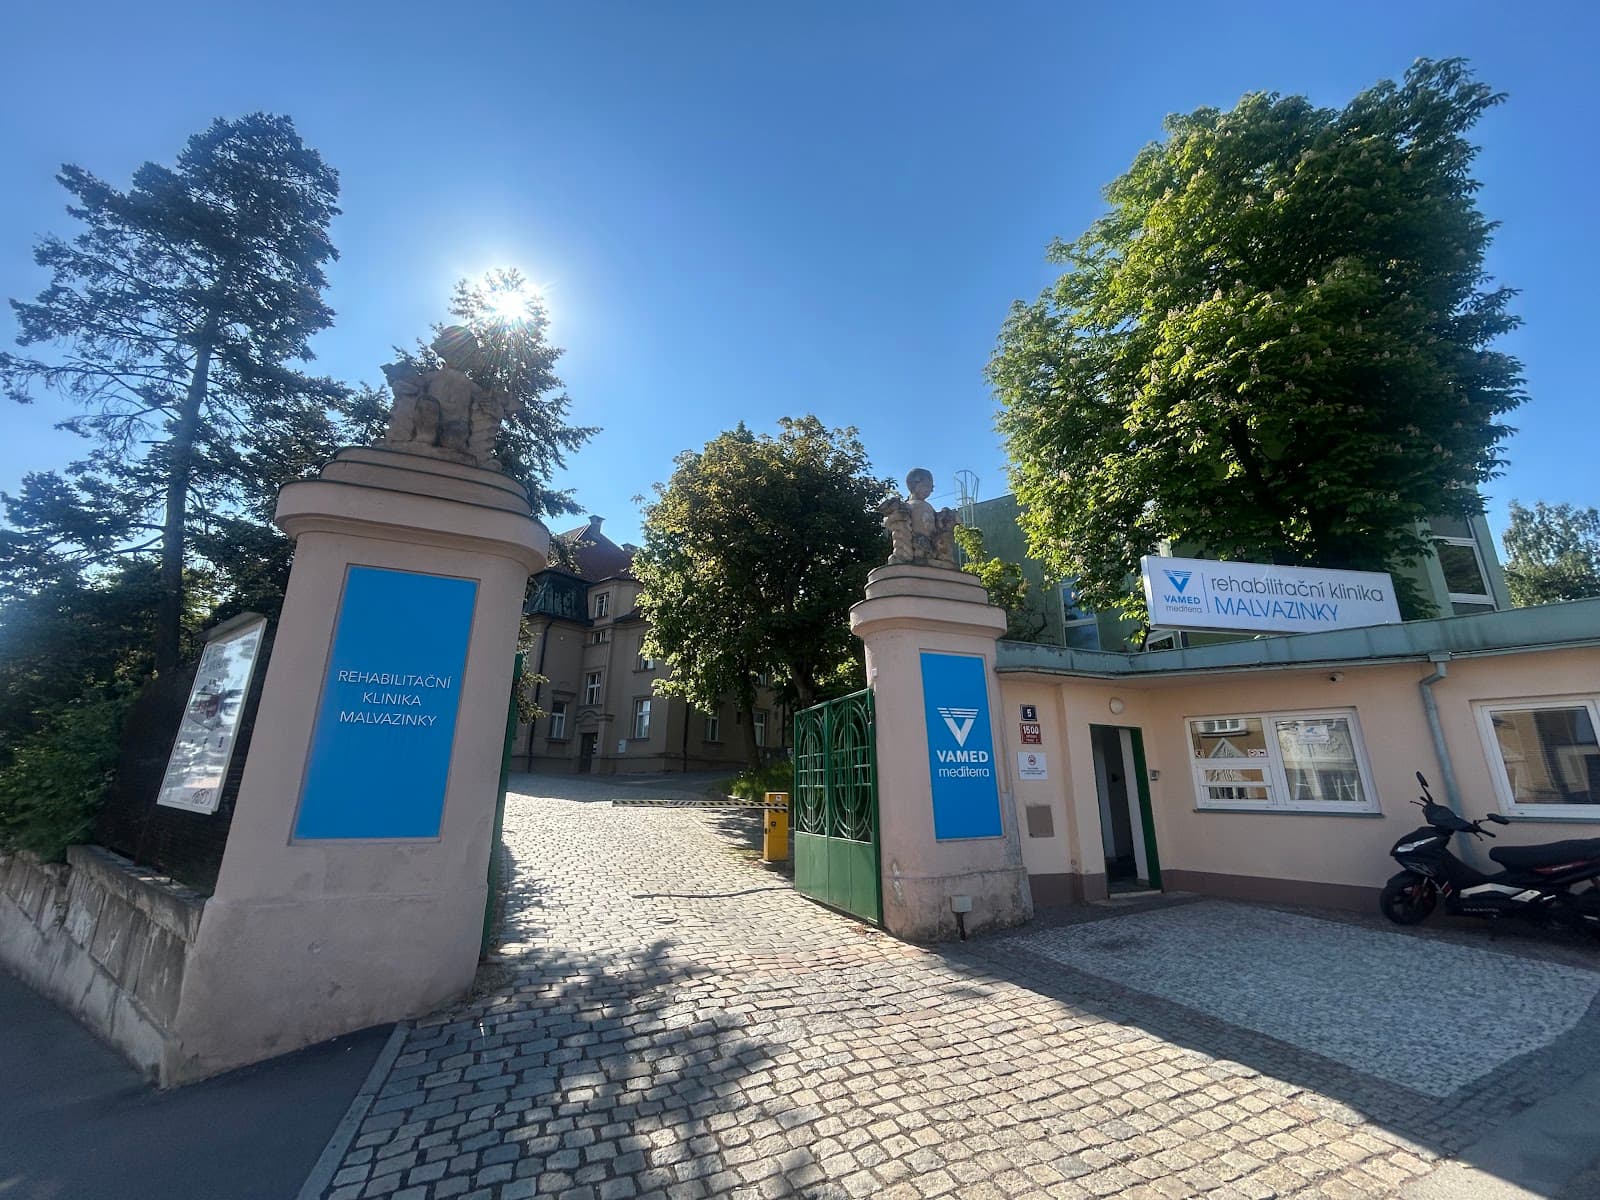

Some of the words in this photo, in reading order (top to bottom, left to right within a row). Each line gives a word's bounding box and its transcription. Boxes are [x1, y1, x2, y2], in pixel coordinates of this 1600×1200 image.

[1211, 576, 1325, 598] rehabilitační
[1329, 582, 1385, 602] klinika
[1163, 594, 1201, 605] VAMED
[1214, 596, 1338, 622] MALVAZINKY
[338, 670, 452, 689] REHABILITAČNÍ
[362, 691, 422, 706] KLINIKA
[339, 711, 438, 727] MALVAZINKY
[1022, 725, 1039, 735] 1500
[936, 750, 989, 763] VAMED
[938, 766, 990, 778] mediterra
